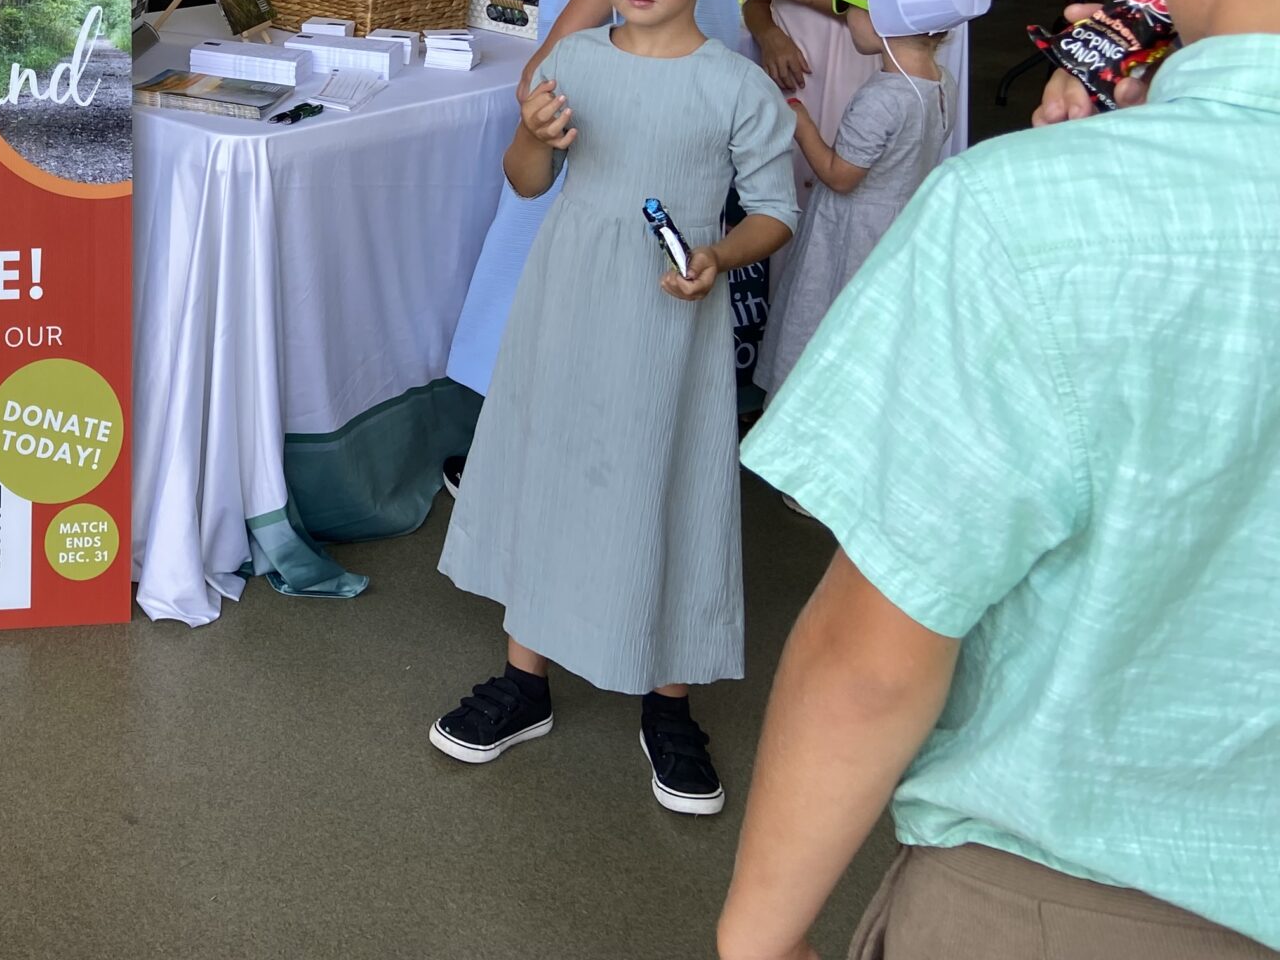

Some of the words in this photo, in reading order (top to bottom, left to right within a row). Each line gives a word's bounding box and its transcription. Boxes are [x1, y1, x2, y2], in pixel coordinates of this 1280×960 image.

[1060, 38, 1106, 71] CANDY
[3, 325, 64, 348] OUR
[3, 400, 112, 442] DONATE
[1, 429, 101, 470] TODAY!
[58, 521, 108, 534] MATCH
[65, 536, 101, 549] ENDS
[58, 551, 90, 563] DEC.
[94, 550, 109, 562] 31
